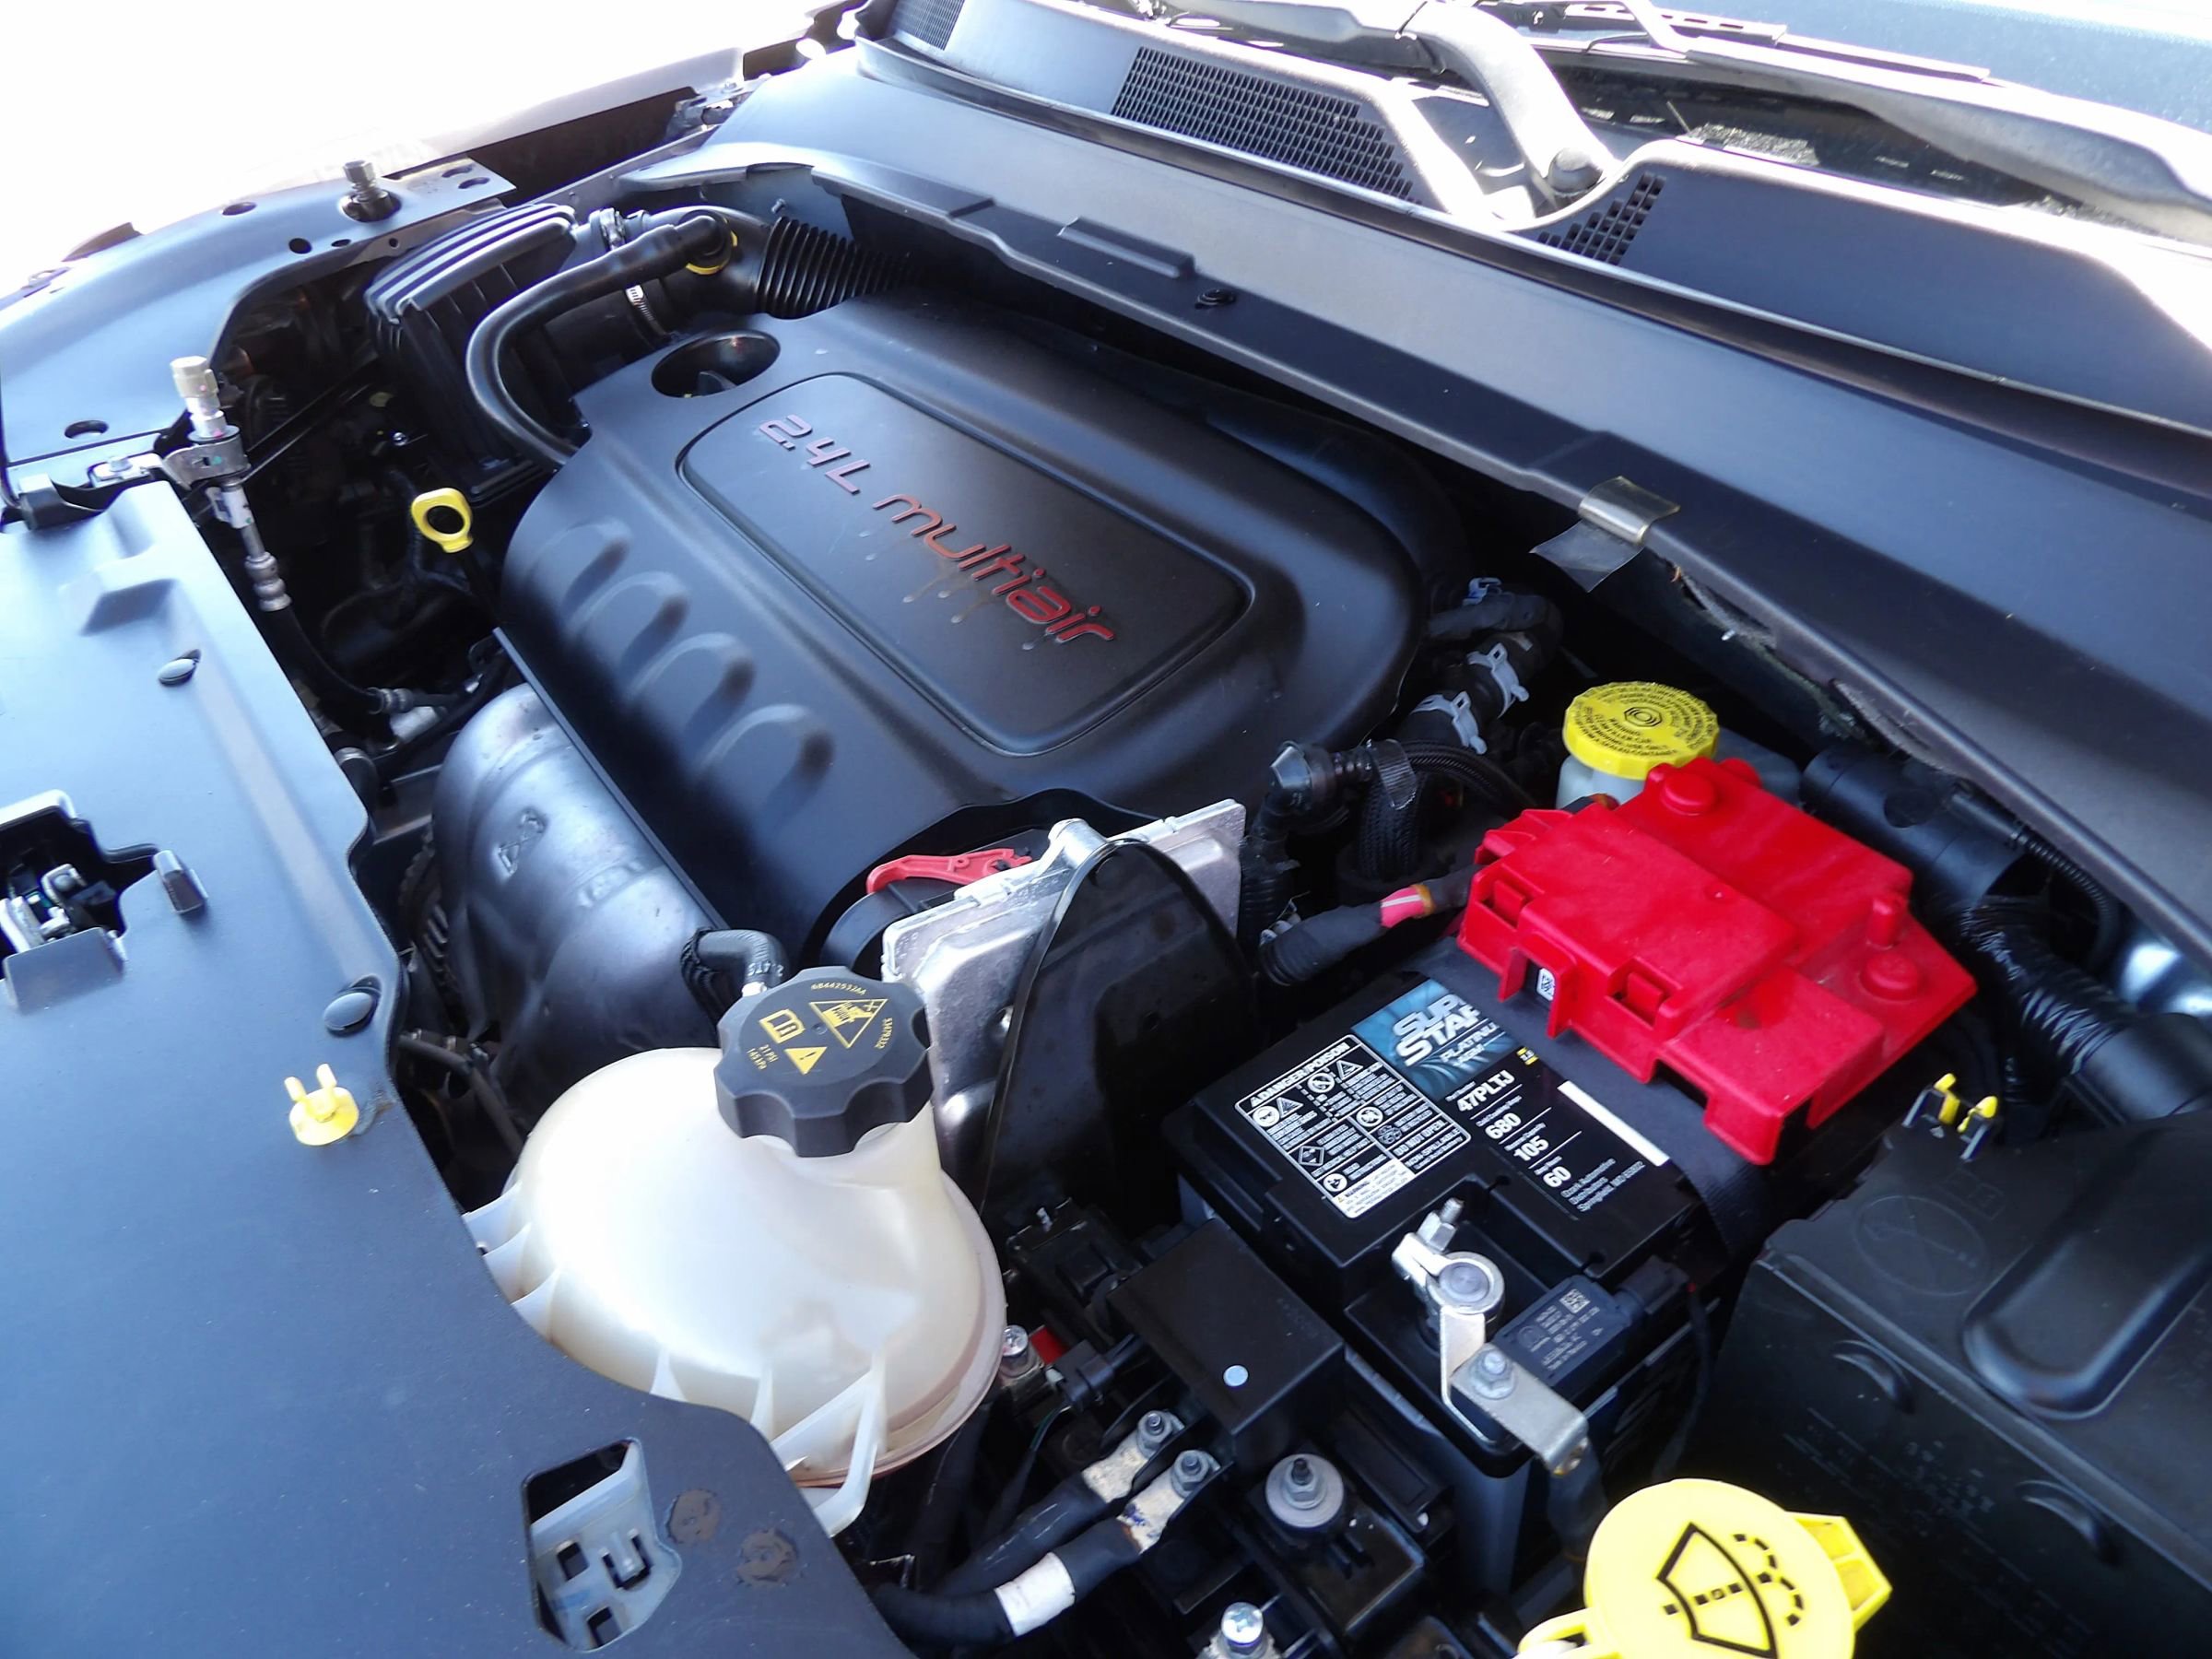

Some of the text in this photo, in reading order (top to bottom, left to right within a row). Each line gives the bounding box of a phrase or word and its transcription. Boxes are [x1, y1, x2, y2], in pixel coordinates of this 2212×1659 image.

[759, 414, 1115, 643] 2.4L multiair
[1393, 994, 1468, 1042] SUP
[1439, 1022, 1500, 1063] PLATINU
[1457, 1070, 1514, 1112] 47PLTJ
[1485, 1112, 1522, 1139] 680
[1513, 1135, 1549, 1161] 105
[1543, 1166, 1571, 1188] 60
